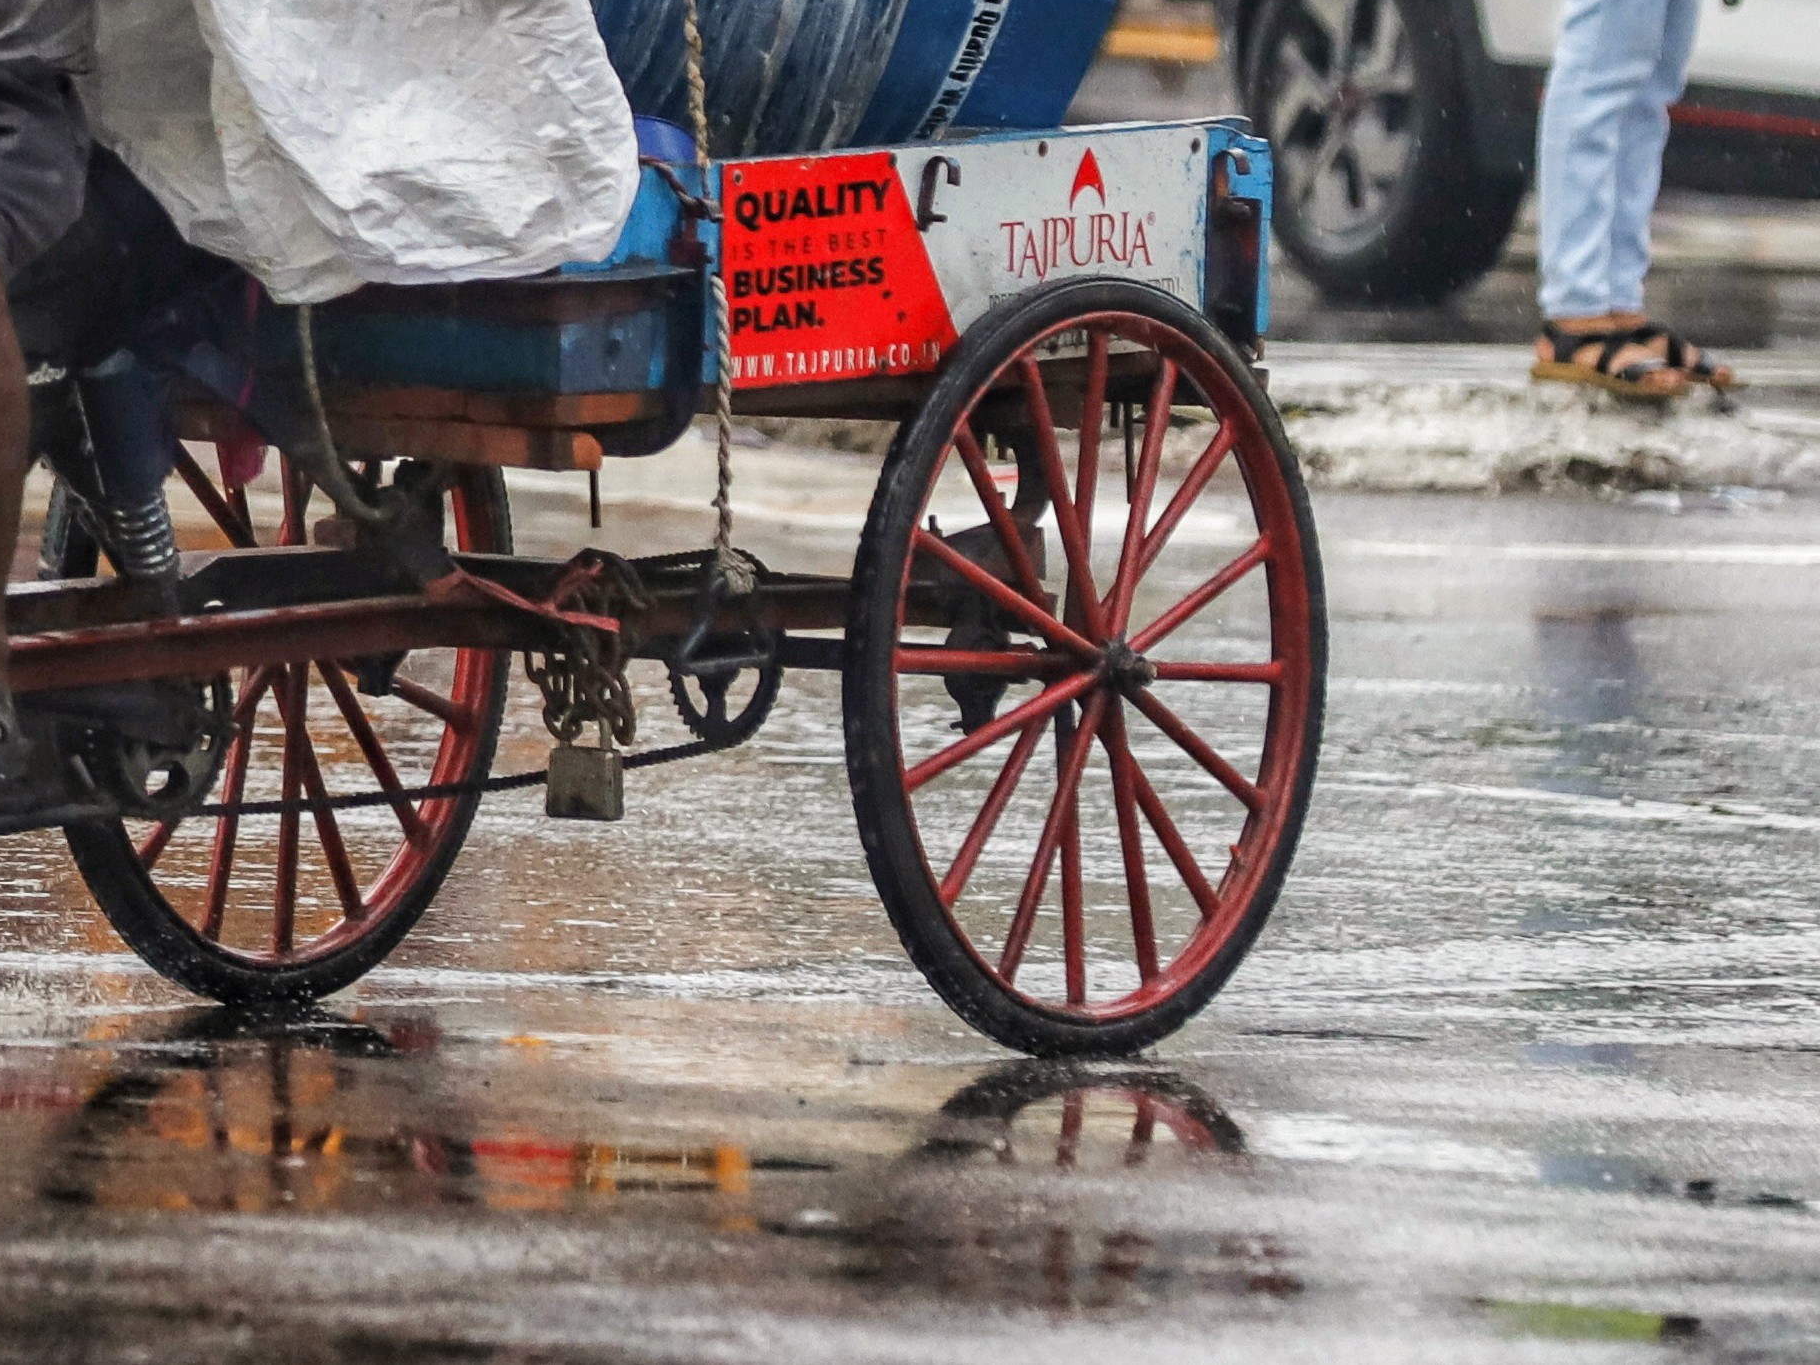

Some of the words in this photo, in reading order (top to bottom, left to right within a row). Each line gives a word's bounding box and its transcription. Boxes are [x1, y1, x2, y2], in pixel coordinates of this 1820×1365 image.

[949, 10, 1001, 83] Quality
[735, 178, 892, 232] QUALITY
[732, 241, 755, 261] IS
[768, 236, 813, 258] THE
[829, 229, 887, 253] BEST
[733, 256, 885, 299] BUSINESS
[733, 300, 825, 335] PLAN.
